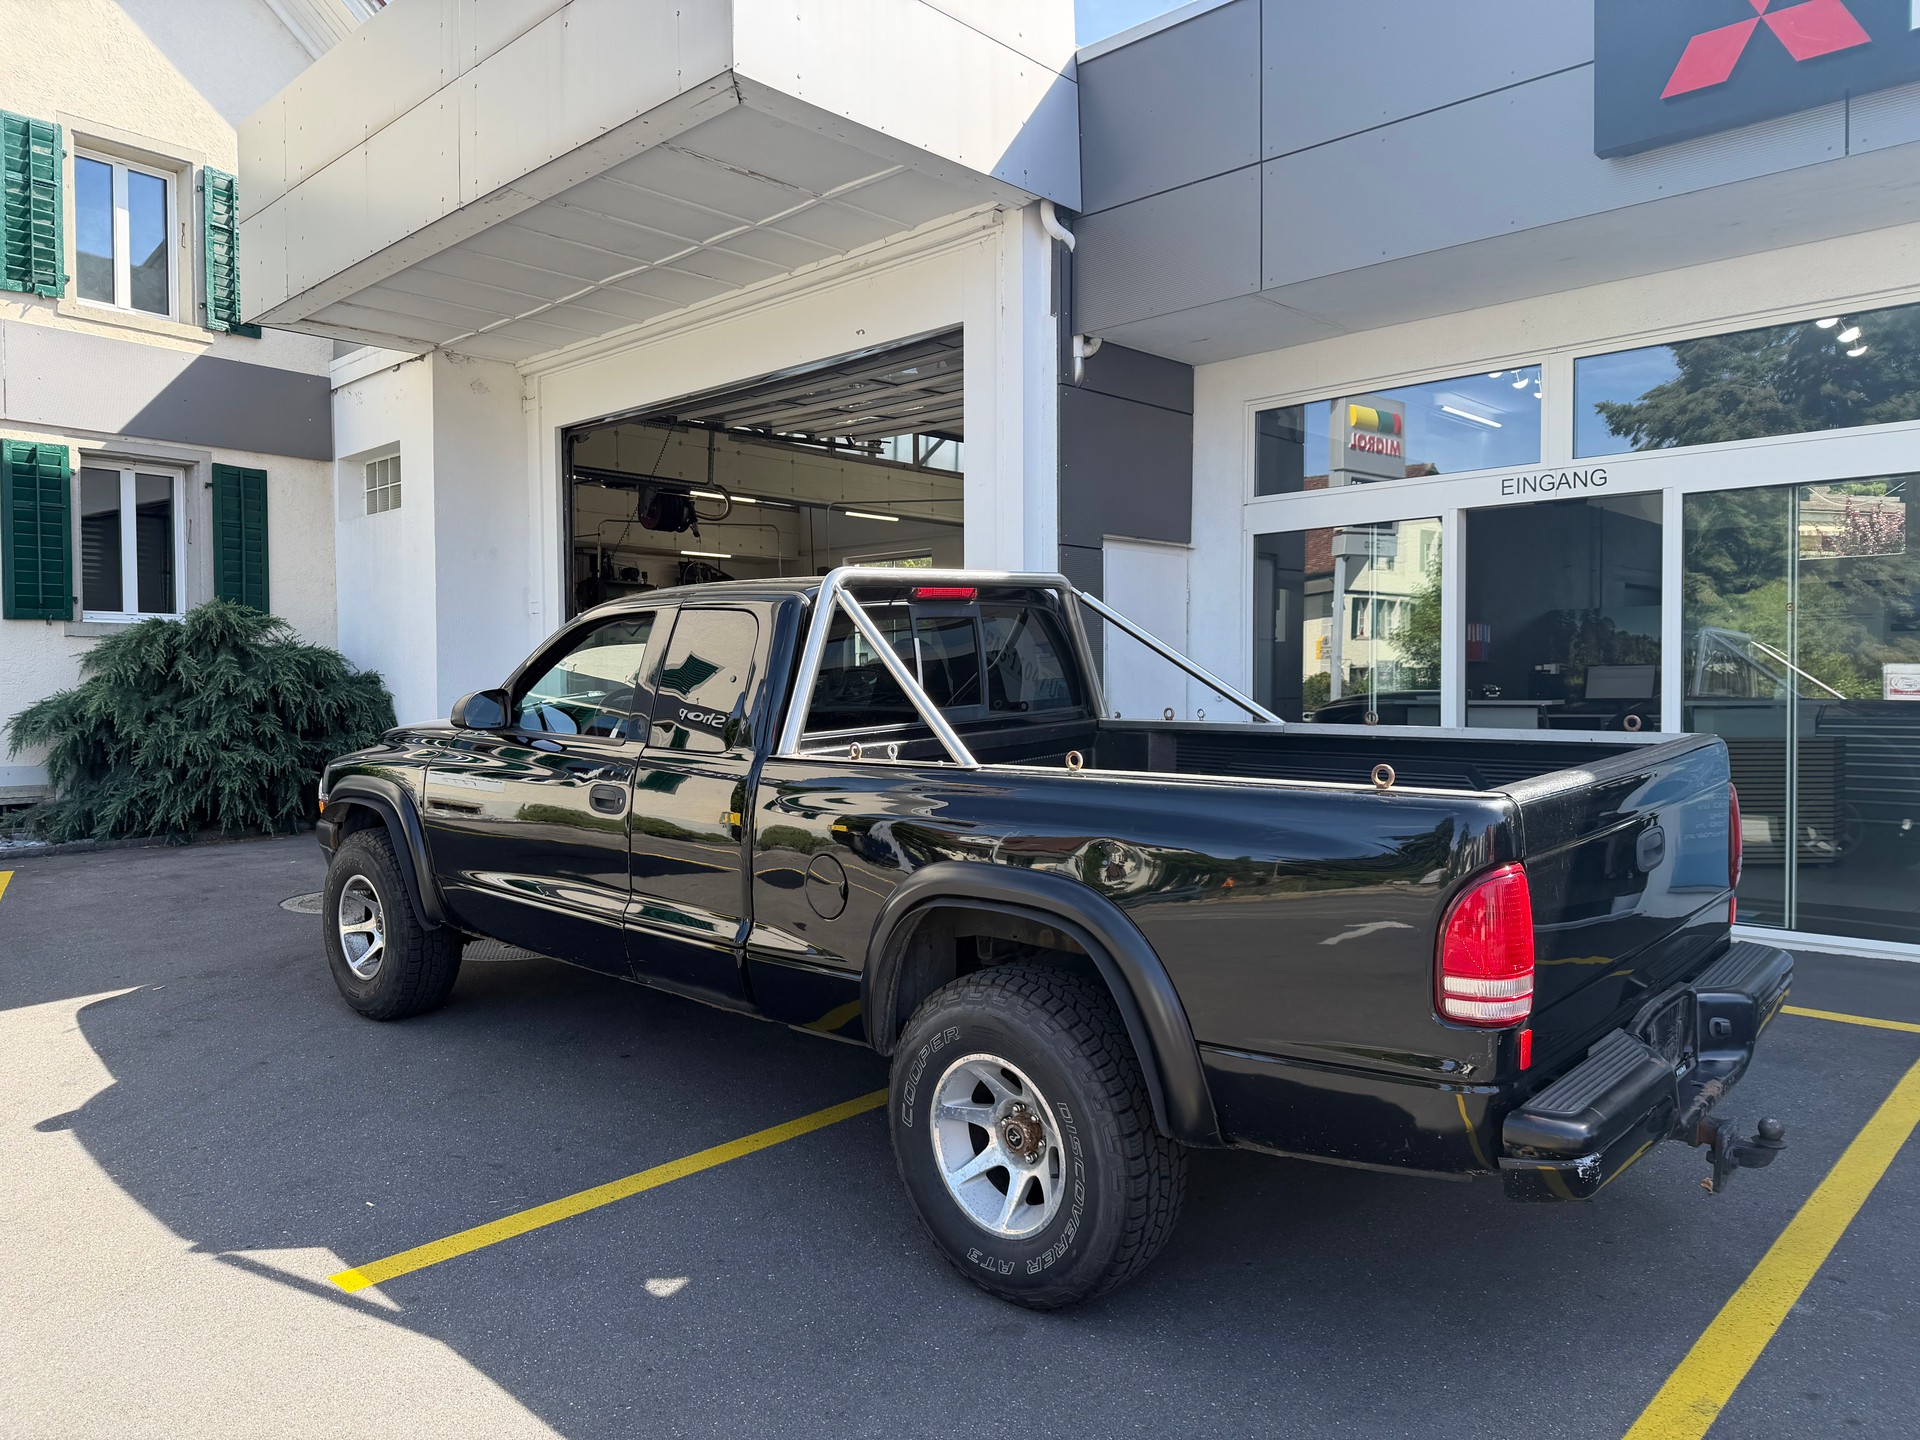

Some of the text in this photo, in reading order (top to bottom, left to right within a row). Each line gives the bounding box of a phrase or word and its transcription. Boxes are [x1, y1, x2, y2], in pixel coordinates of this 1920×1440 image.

[1501, 468, 1608, 496] EINGANG
[901, 1026, 961, 1128] COOPER
[966, 1102, 1087, 1275] DISCOVERER AT3
